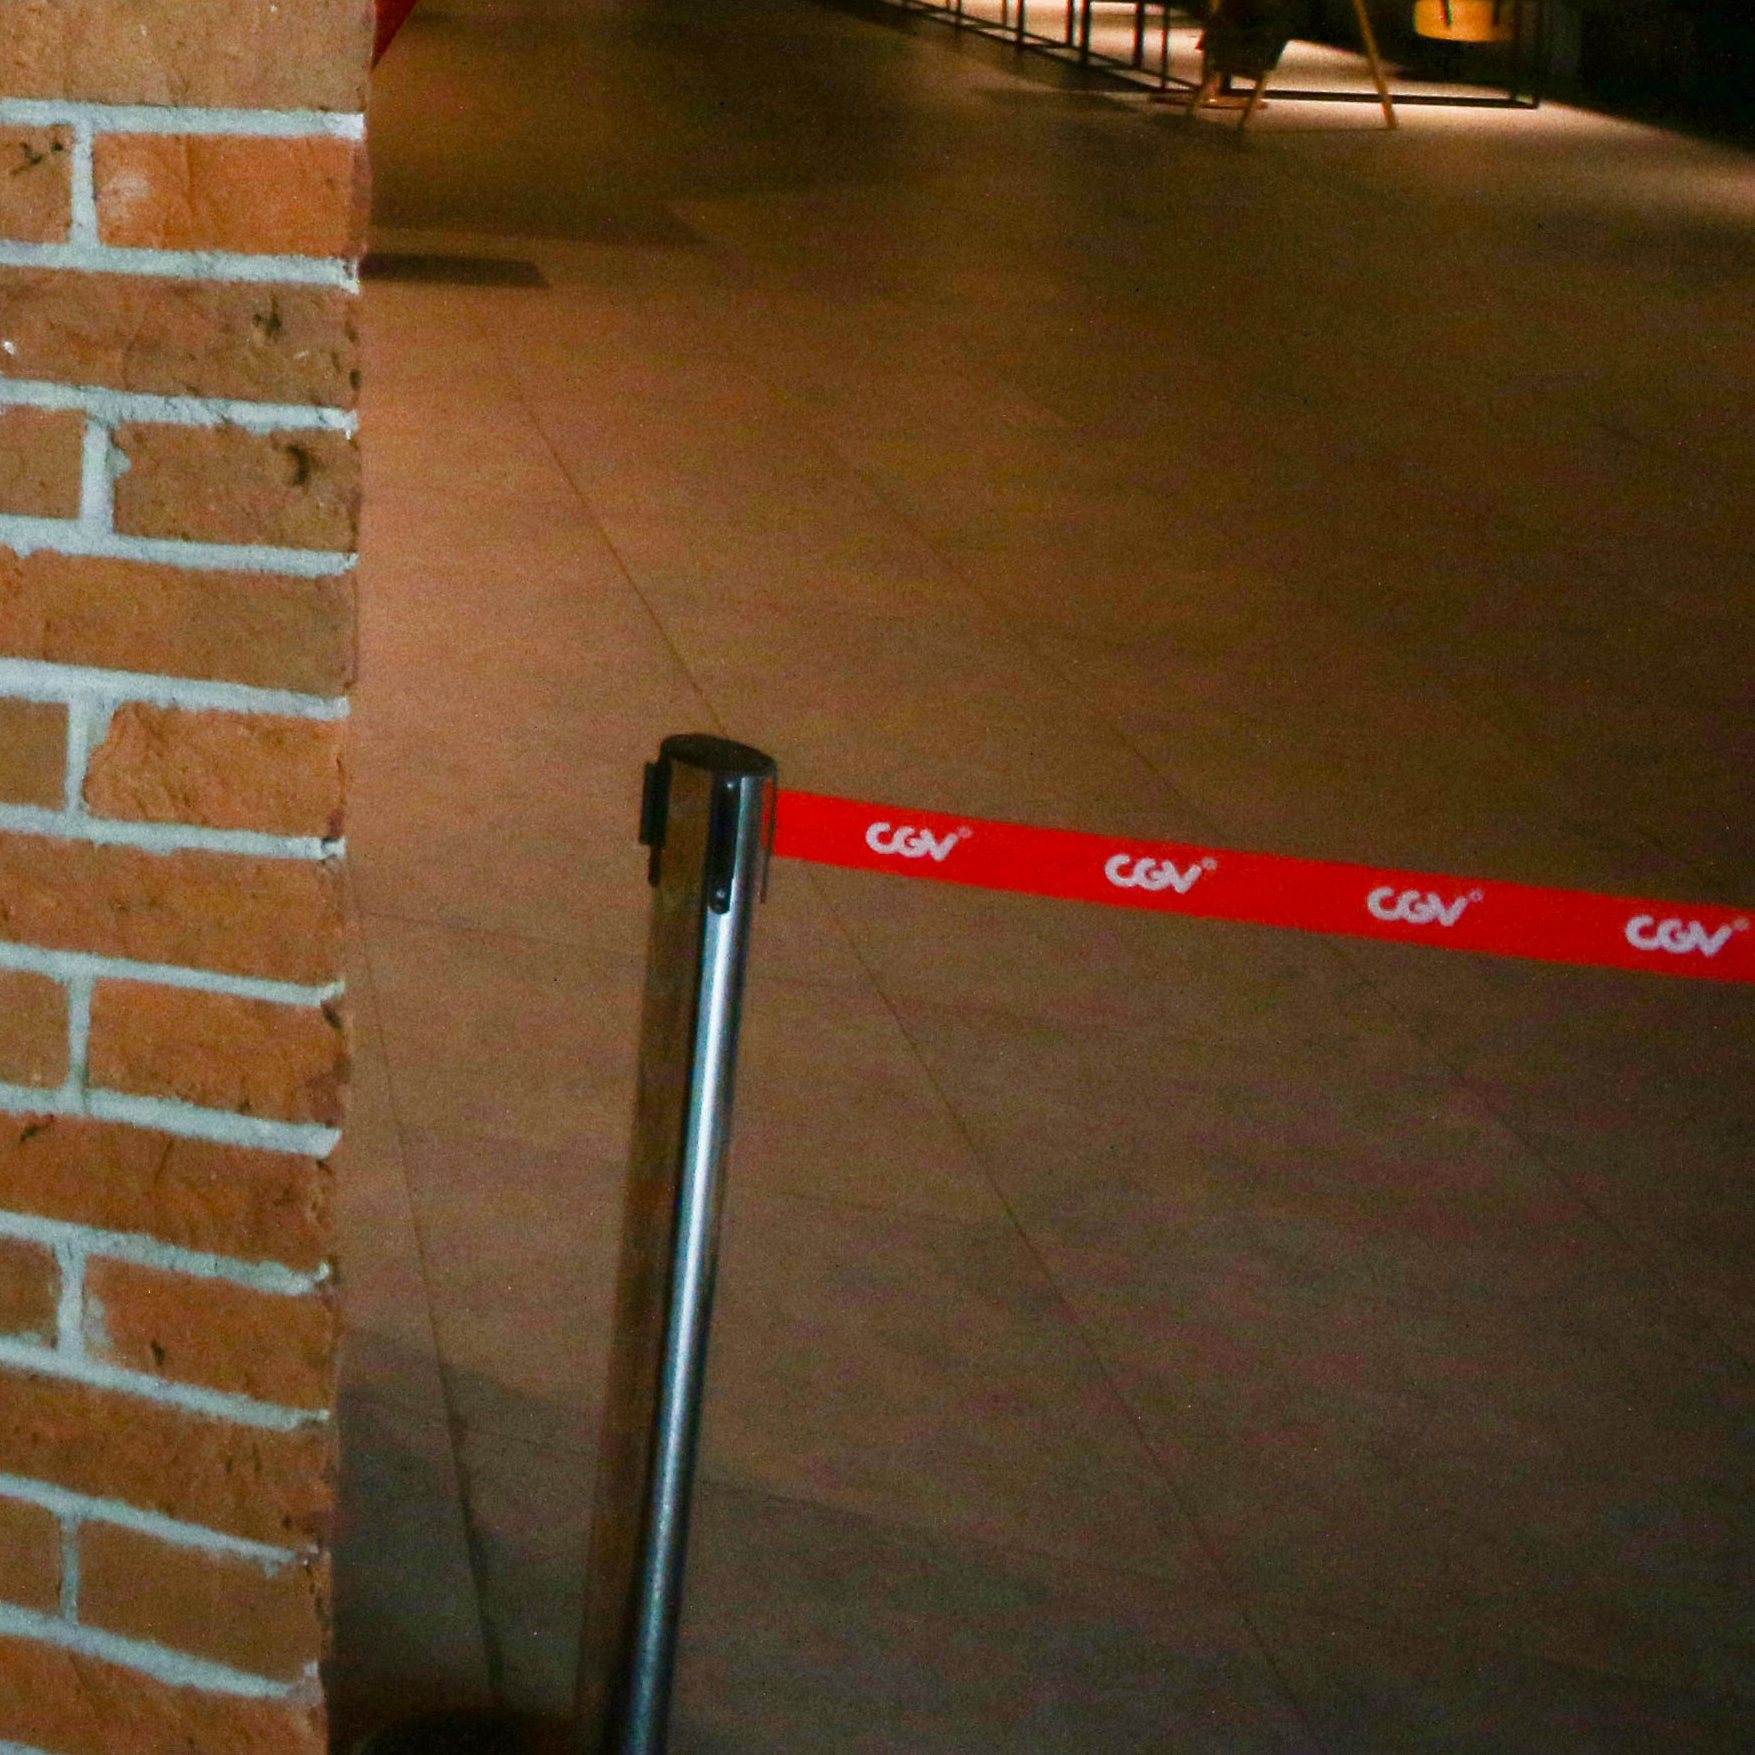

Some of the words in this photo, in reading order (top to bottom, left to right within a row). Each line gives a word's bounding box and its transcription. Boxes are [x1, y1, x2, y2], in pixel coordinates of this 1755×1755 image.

[865, 821, 958, 862] CGV
[1104, 853, 1202, 895] CGV
[1366, 886, 1469, 927] CGV
[1623, 914, 1734, 958] CGV
